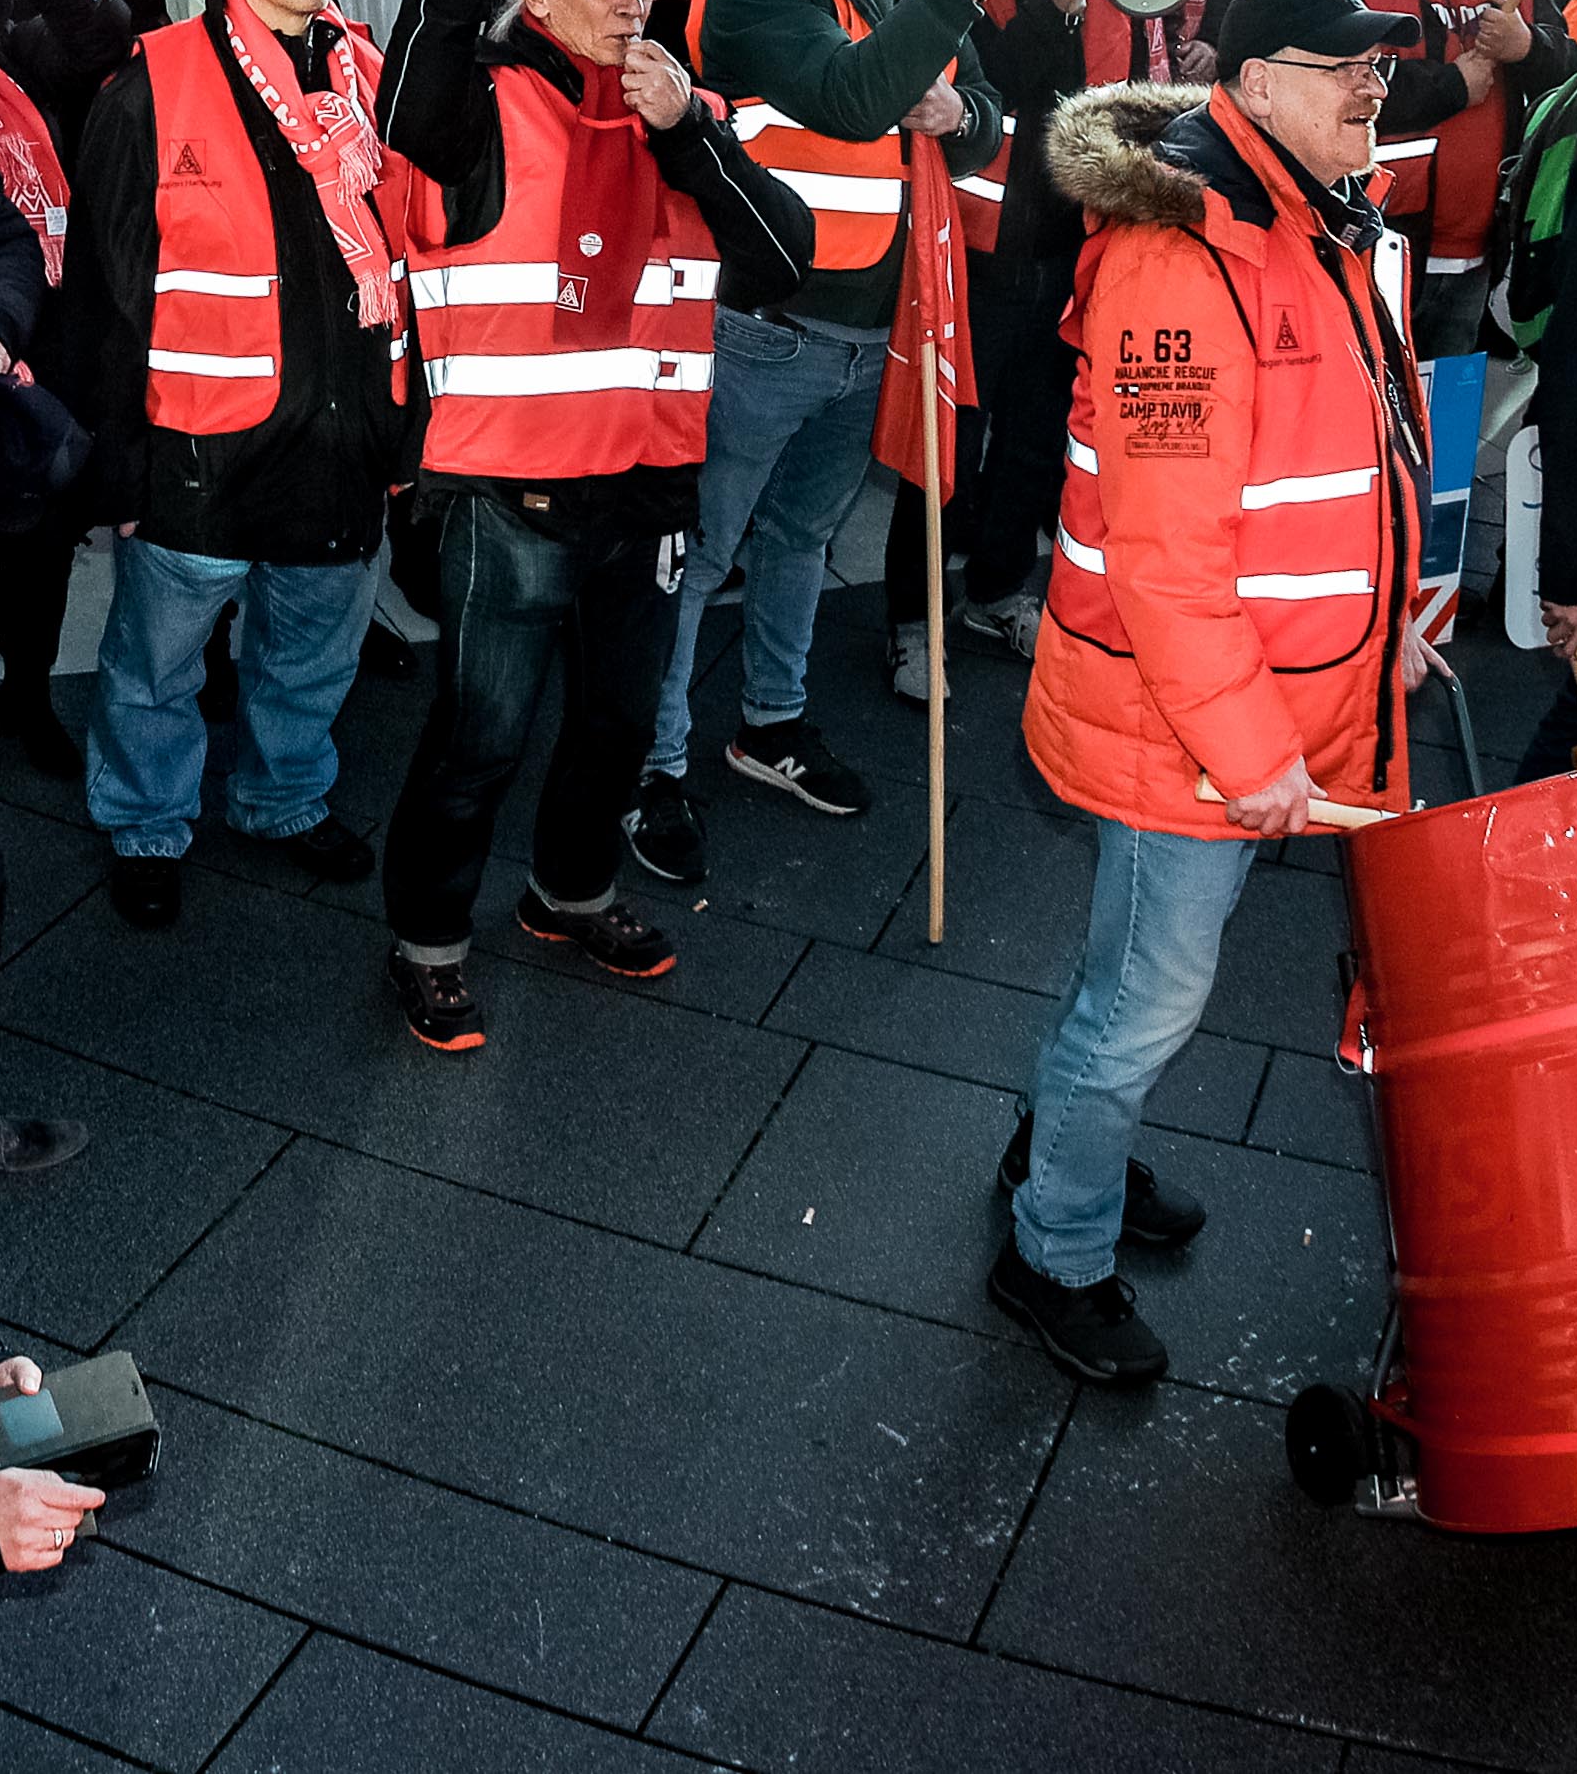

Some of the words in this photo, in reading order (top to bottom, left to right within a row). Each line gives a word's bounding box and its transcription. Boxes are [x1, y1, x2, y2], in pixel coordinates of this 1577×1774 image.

[1154, 329, 1192, 363] 63
[1174, 367, 1218, 380] RESCUE
[1120, 402, 1157, 419] CAMP
[1160, 402, 1202, 419] DAVID
